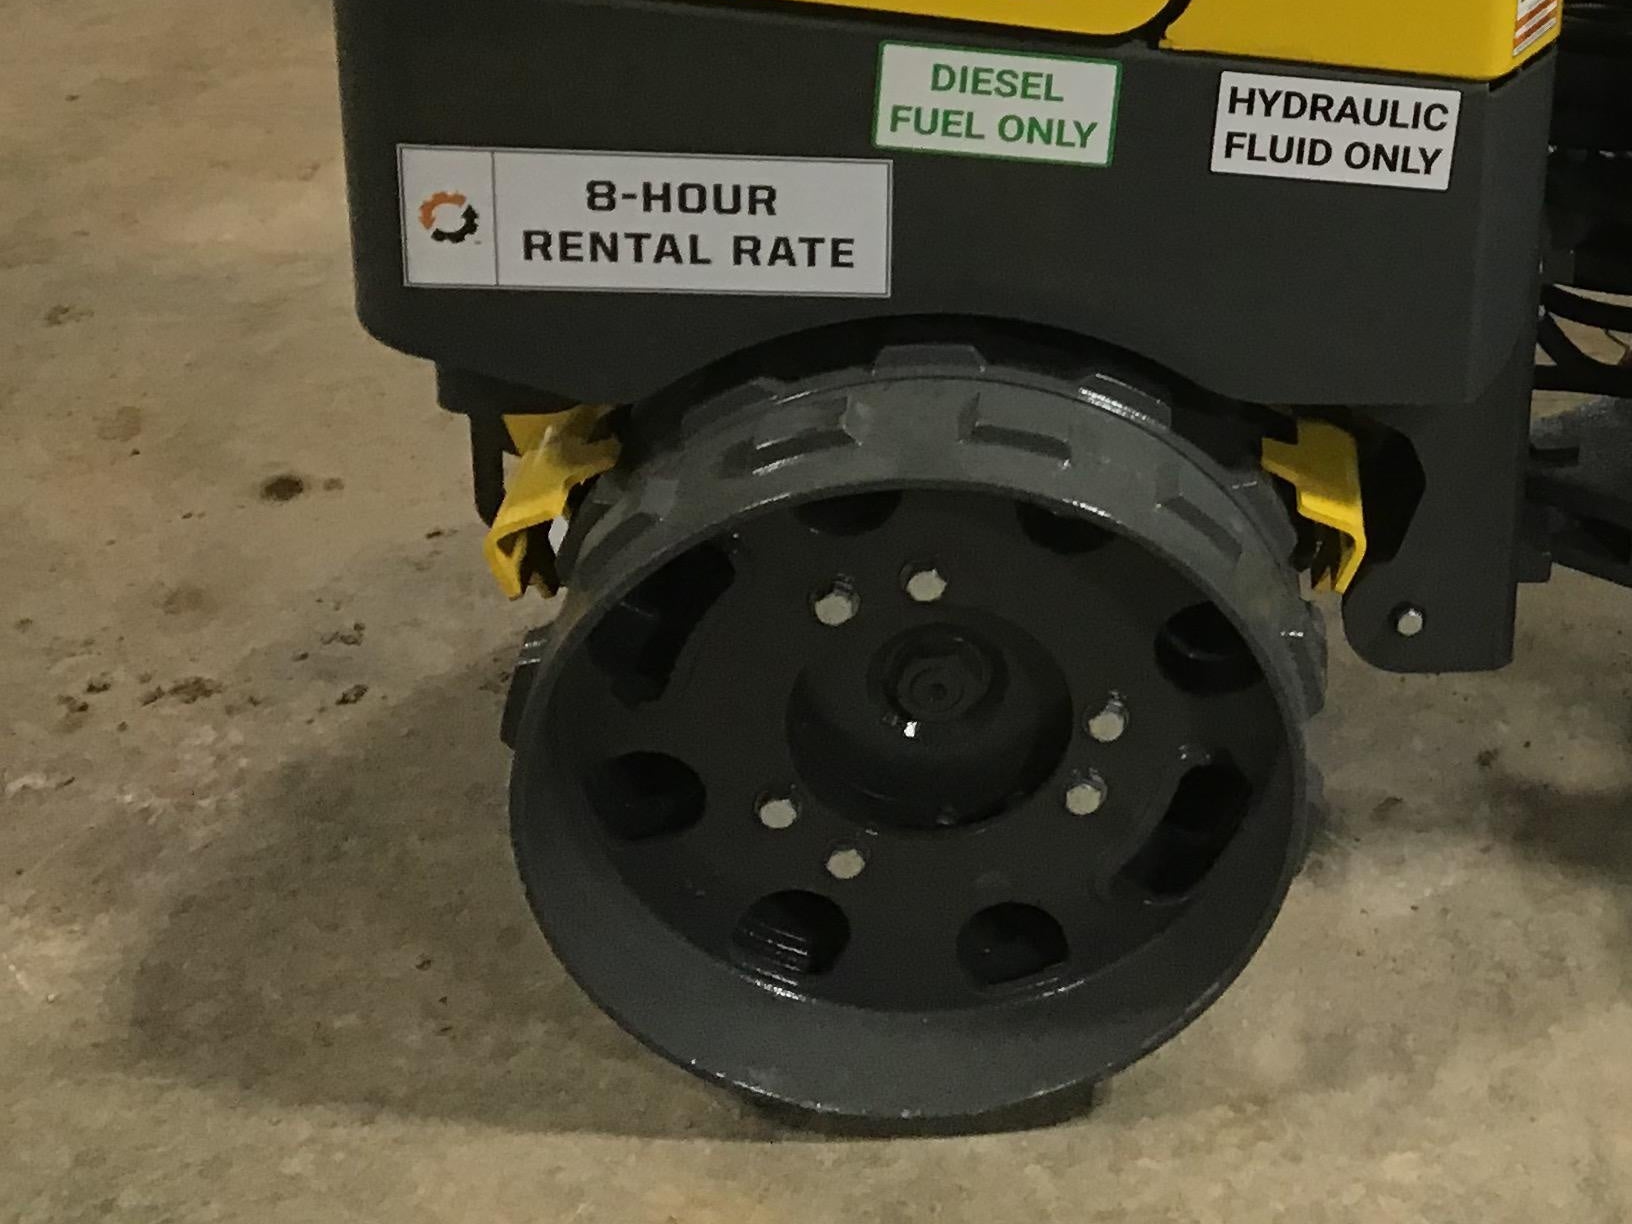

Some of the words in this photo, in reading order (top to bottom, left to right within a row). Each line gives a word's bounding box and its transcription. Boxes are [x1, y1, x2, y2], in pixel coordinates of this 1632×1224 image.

[931, 63, 1064, 102] DIESEL
[889, 107, 985, 139] FUEL
[999, 114, 1098, 149] ONLY
[1227, 86, 1449, 132] HYDRAULIC
[1223, 131, 1333, 167] FLUID
[1344, 139, 1443, 176] ONLY
[586, 180, 778, 216] 8-HOUR
[522, 229, 712, 265] RENTAL
[732, 236, 856, 269] RATE
